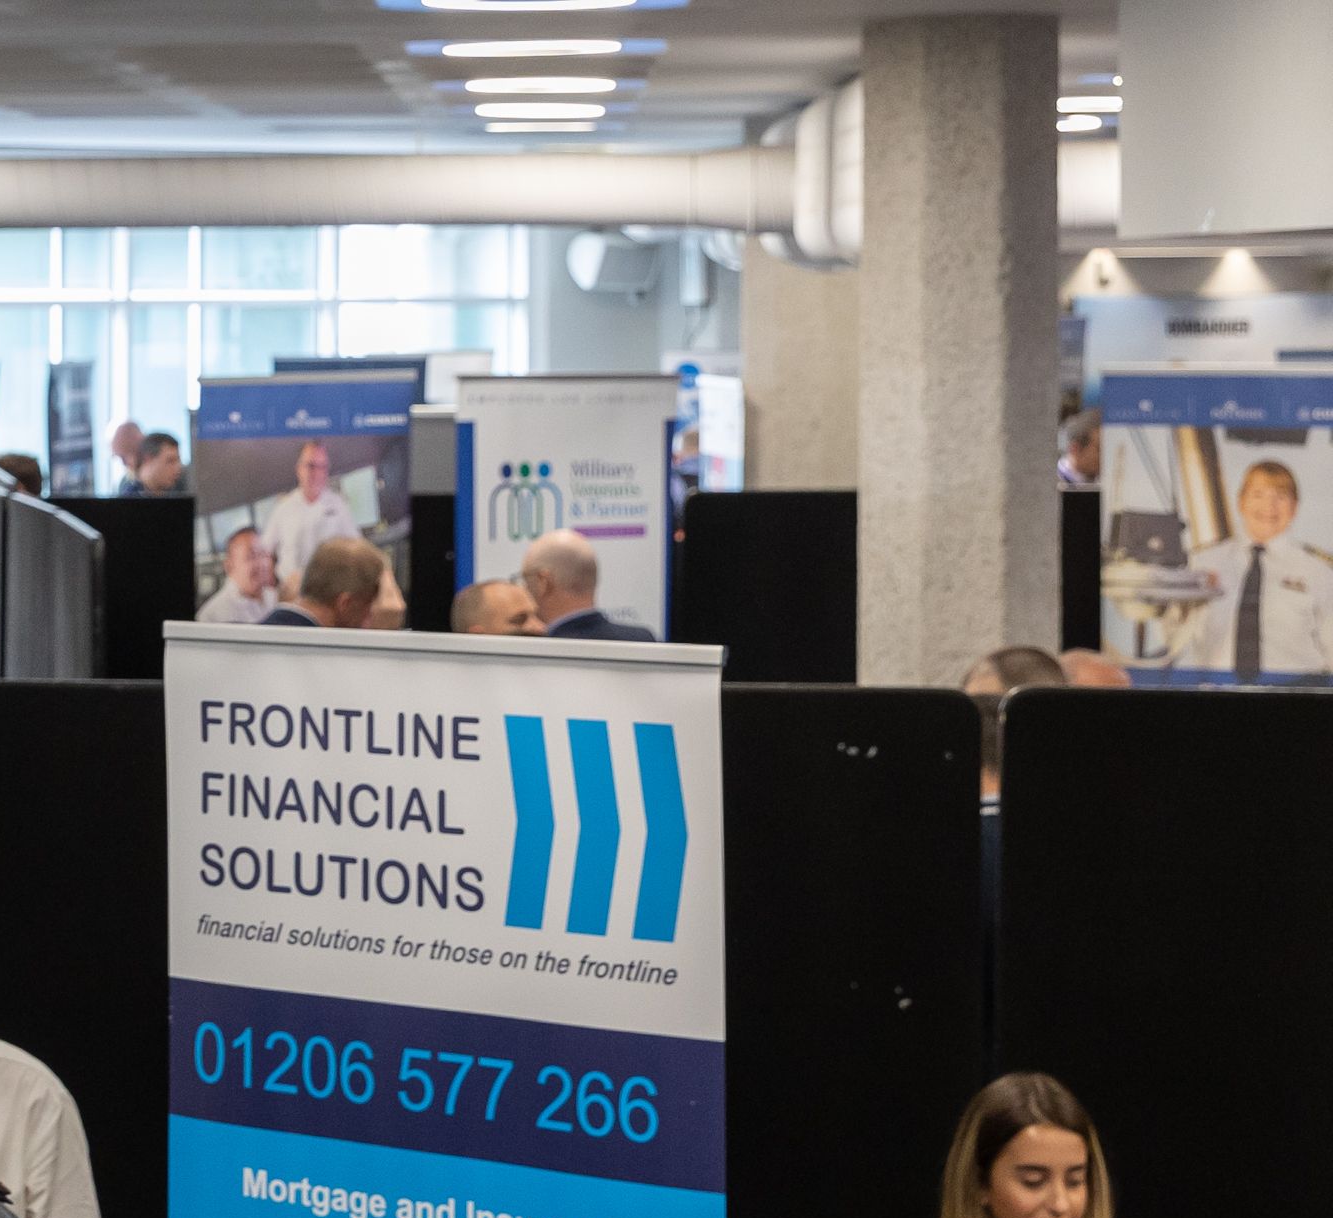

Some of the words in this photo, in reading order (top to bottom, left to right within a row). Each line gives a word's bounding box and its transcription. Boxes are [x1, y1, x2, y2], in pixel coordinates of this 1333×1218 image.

[199, 700, 482, 761] FRONTLINE
[200, 772, 466, 836] FINANCIAL
[199, 842, 485, 913] SOLUTIONS
[196, 914, 284, 945] financial
[286, 926, 385, 956] solutions
[391, 935, 424, 960] for
[429, 939, 493, 966] those
[499, 949, 528, 970] on
[534, 951, 571, 976] the
[576, 955, 679, 987] frontline
[193, 1021, 376, 1106] 01206
[397, 1047, 515, 1122] 577
[535, 1066, 660, 1144] 266
